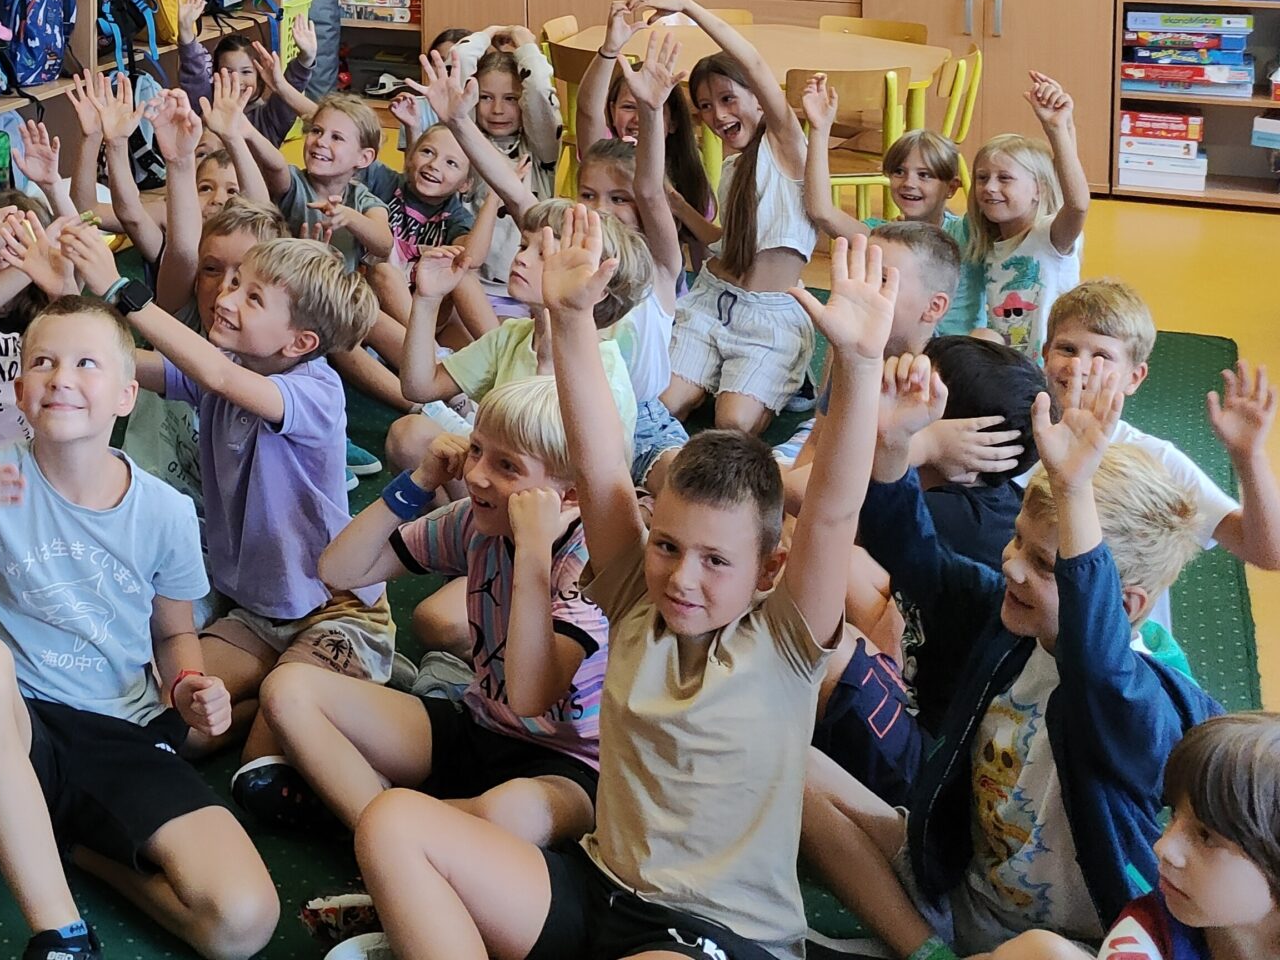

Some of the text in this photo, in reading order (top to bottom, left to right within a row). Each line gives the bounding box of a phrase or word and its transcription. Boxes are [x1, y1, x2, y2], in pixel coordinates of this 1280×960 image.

[40, 649, 108, 672] 海の中で
[480, 674, 584, 721] AIYS
